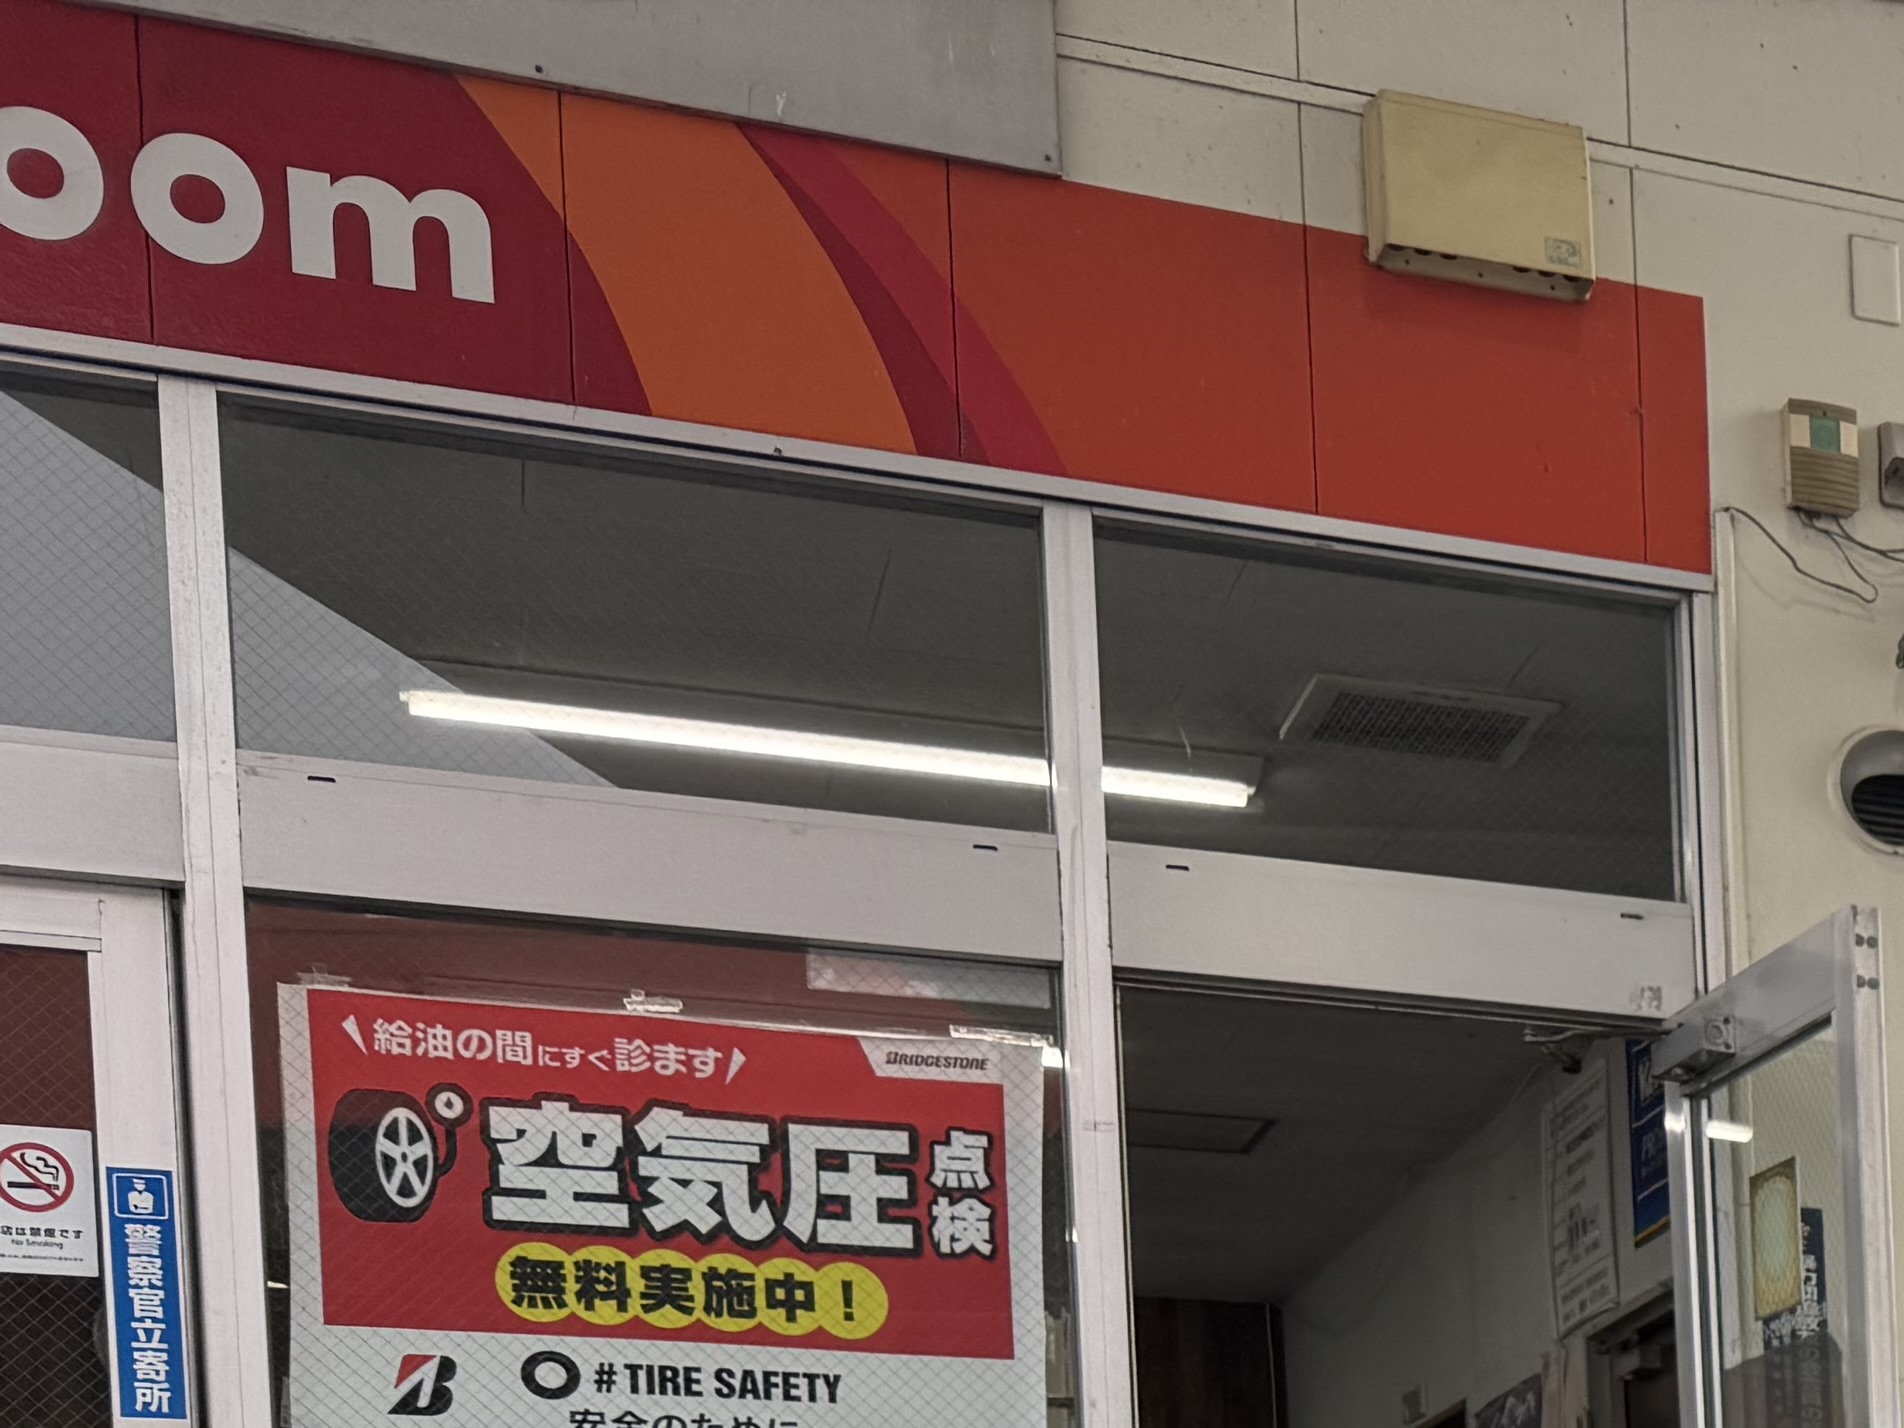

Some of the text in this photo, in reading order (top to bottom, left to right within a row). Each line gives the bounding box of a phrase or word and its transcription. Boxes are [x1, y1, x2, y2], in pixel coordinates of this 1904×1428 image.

[0, 105, 497, 304] oom
[373, 1019, 724, 1080] 給油の間にすぐ診ます
[885, 1050, 989, 1072] BRIDGESTONE
[486, 1098, 916, 1251] 空気圧
[929, 1130, 993, 1258] 点検
[124, 1223, 172, 1414] 警察官立寄所
[509, 1256, 856, 1324] 無料実施中！
[714, 1367, 843, 1403] SAFETY
